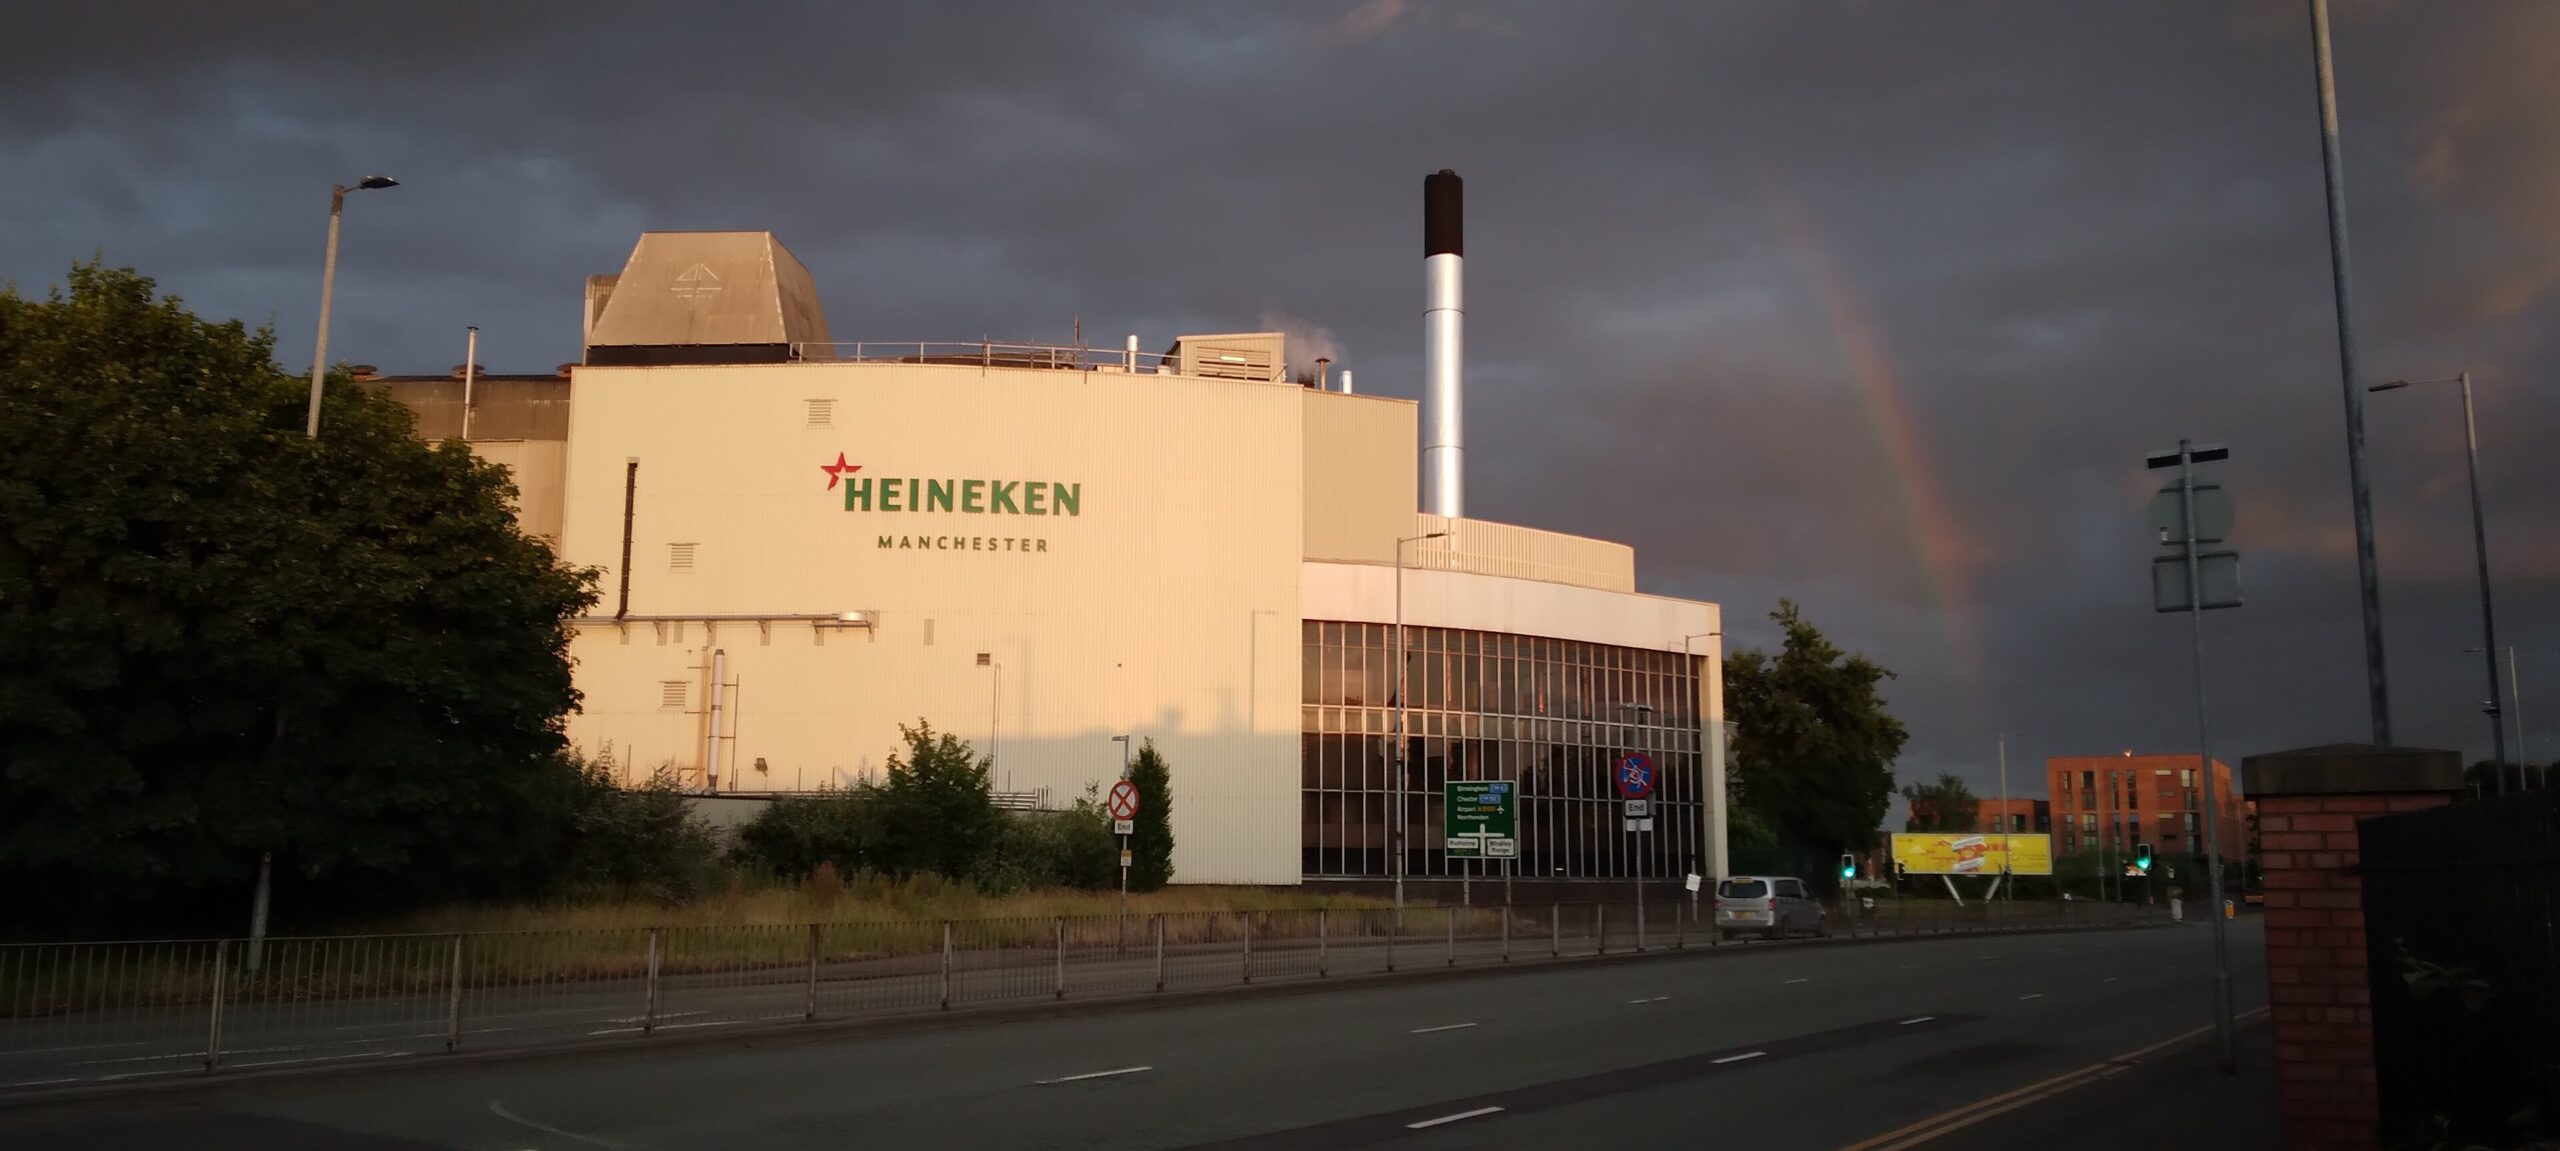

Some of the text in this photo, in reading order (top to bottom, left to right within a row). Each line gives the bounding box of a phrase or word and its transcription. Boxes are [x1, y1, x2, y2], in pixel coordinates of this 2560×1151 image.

[844, 478, 1081, 517] HEINEKEN
[877, 535, 1048, 553] MANCHESTER
[1629, 803, 1644, 811] End
[1117, 823, 1131, 831] End
